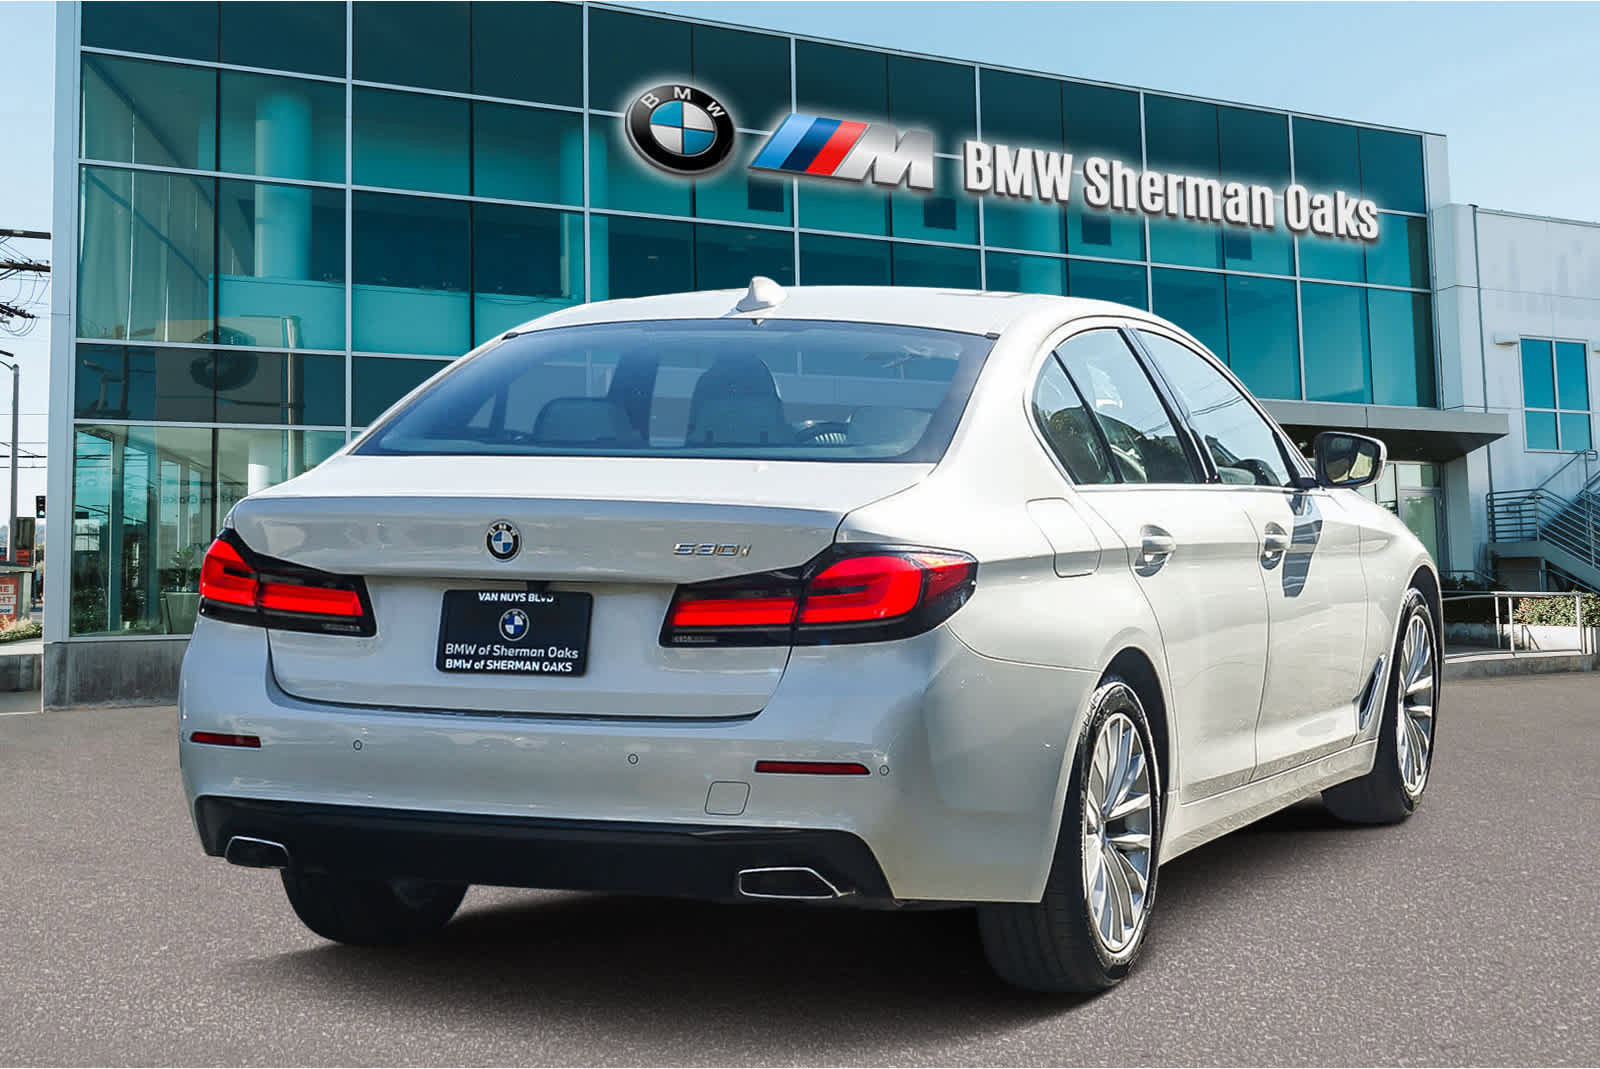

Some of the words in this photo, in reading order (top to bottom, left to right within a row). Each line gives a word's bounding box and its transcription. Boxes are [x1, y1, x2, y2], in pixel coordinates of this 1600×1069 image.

[640, 86, 725, 117] BMW
[964, 140, 1073, 202] BMW
[1083, 156, 1275, 229] Sherman
[1283, 184, 1380, 241] Oaks
[673, 543, 752, 556] 530i
[478, 592, 498, 601] VAN
[500, 593, 527, 602] NUYS
[445, 643, 476, 655] BMW
[478, 645, 491, 656] of
[492, 644, 545, 657] Sherman
[547, 646, 579, 658] Oaks
[445, 658, 473, 669] BMW
[473, 659, 485, 670] of
[486, 660, 540, 671] SHERMAN
[541, 661, 573, 672] OAKS
